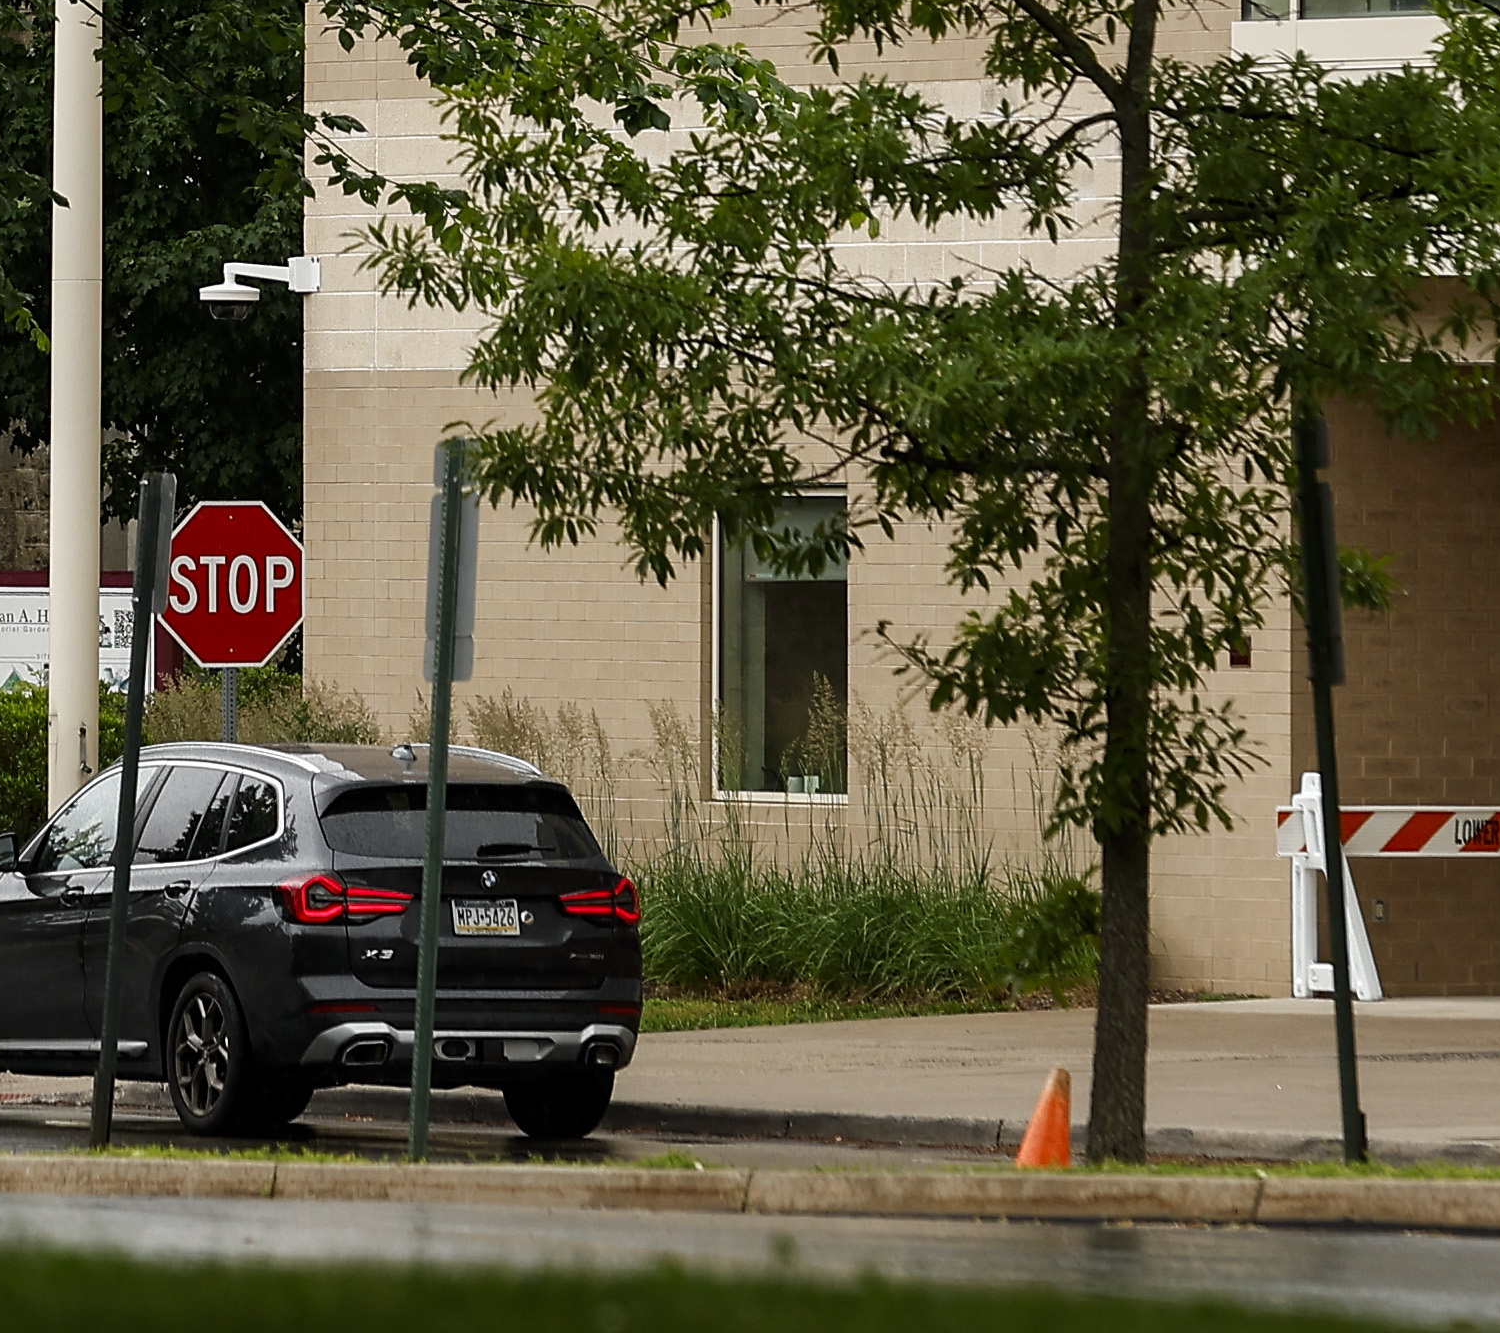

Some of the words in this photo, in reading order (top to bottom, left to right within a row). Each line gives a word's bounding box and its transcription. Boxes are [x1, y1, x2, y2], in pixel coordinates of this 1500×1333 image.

[169, 554, 296, 615] STOP
[18, 608, 33, 623] A.
[1454, 818, 1499, 846] LOWER
[361, 948, 395, 961] X3
